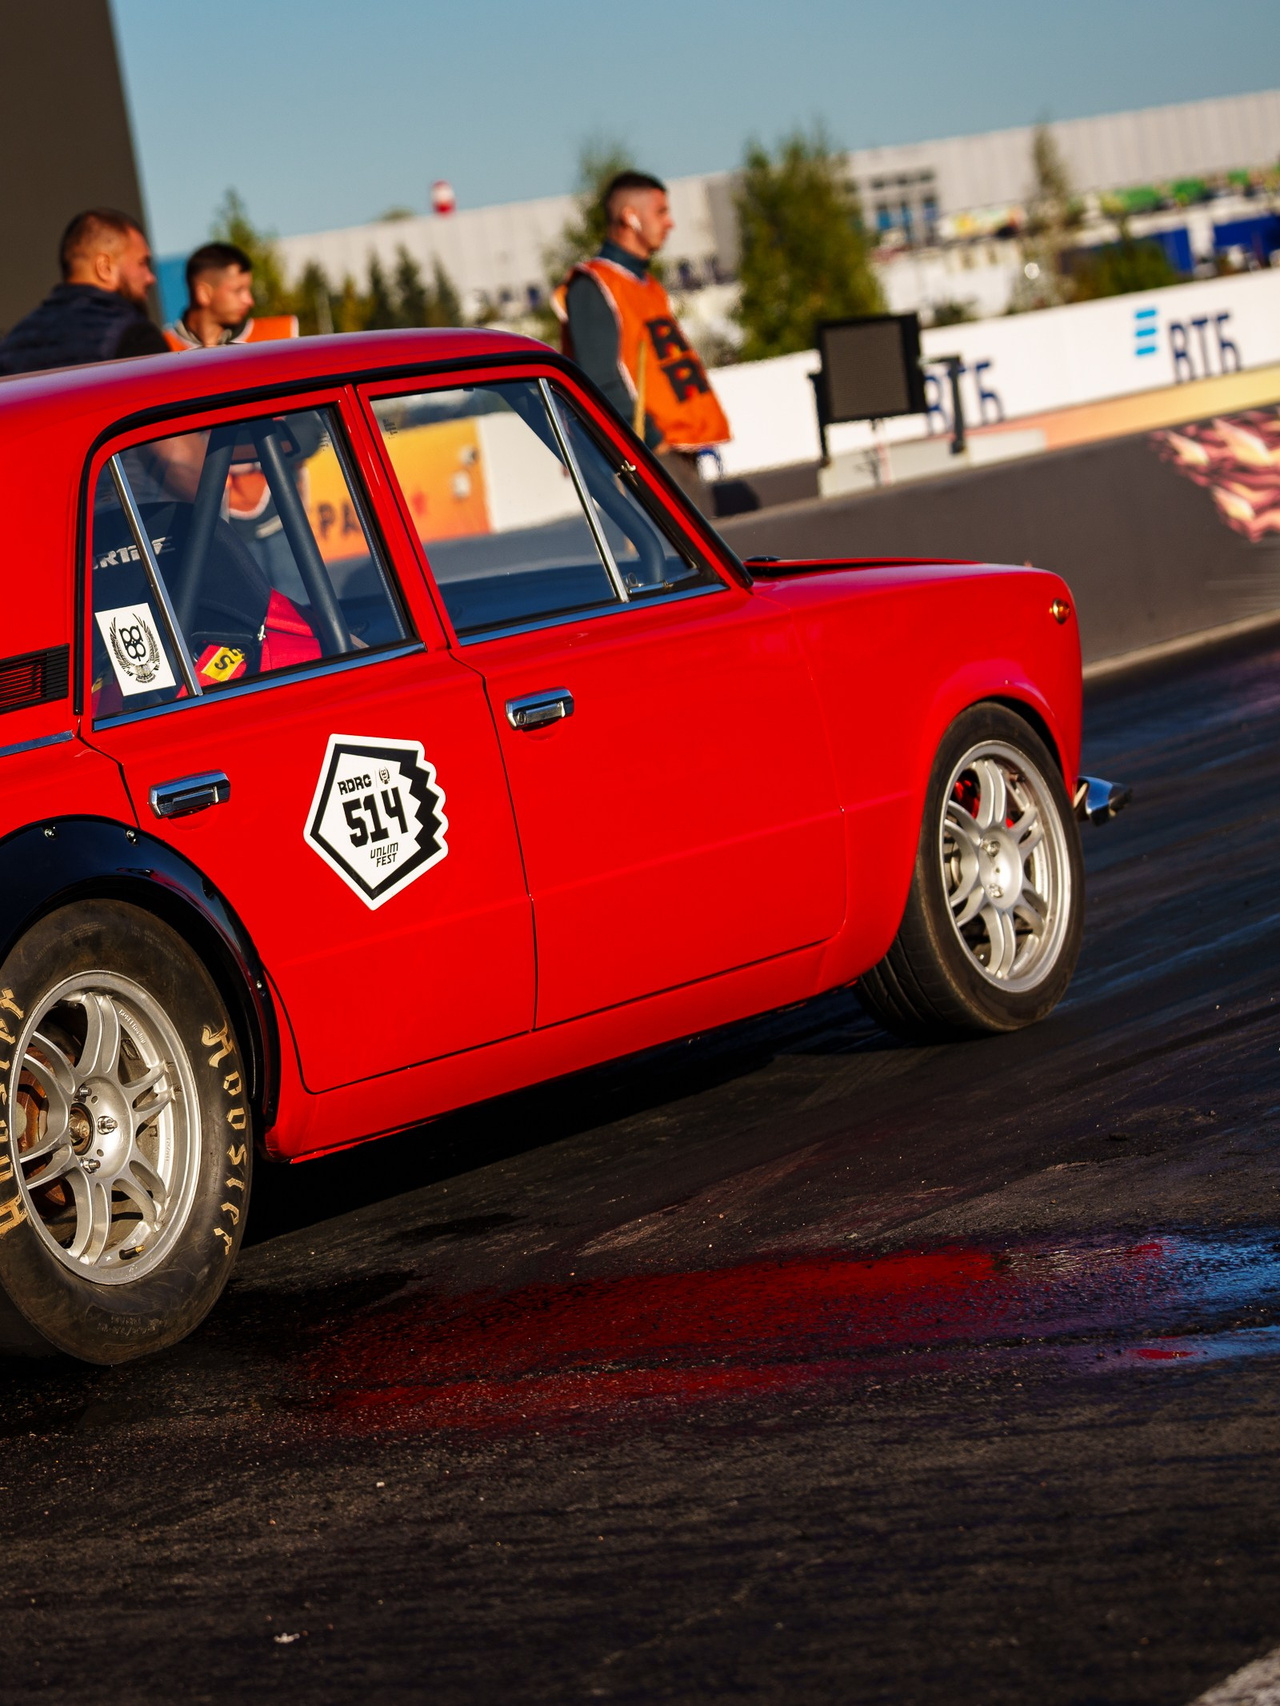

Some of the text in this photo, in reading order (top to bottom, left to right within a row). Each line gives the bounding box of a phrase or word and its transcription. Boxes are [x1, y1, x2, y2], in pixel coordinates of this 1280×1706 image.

[337, 773, 372, 795] RDRC
[342, 786, 409, 848] 514
[370, 842, 399, 859] UNLIM
[376, 853, 397, 868] FEST
